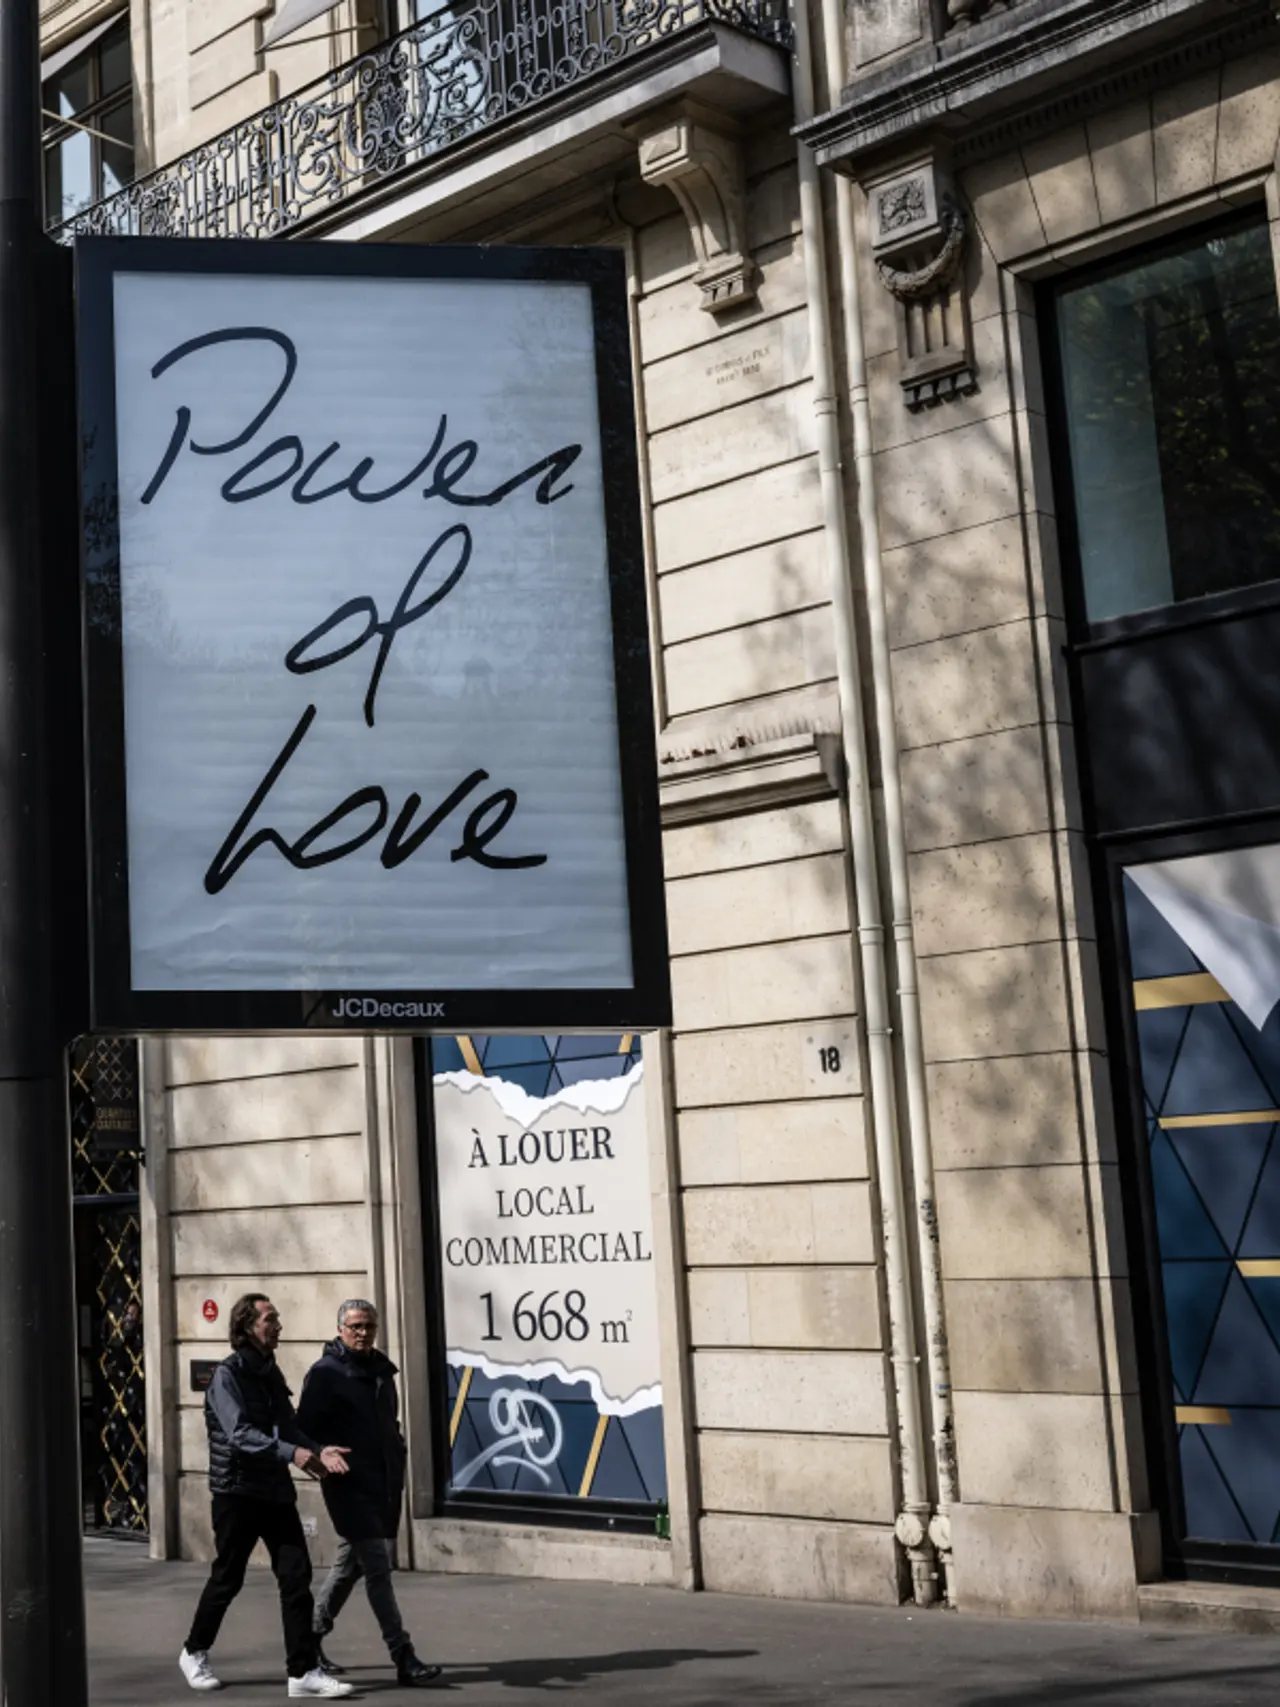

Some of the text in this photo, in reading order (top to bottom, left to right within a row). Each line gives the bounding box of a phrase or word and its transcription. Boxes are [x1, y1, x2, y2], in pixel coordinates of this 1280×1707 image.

[141, 326, 582, 506] Power
[284, 523, 473, 728] of
[203, 703, 548, 895] Love
[332, 998, 445, 1018] JCDecaux
[818, 1046, 841, 1073] 18
[468, 1126, 614, 1168] À LOUER
[496, 1186, 594, 1218] LOCAL
[445, 1231, 652, 1267] COMMERCIAL
